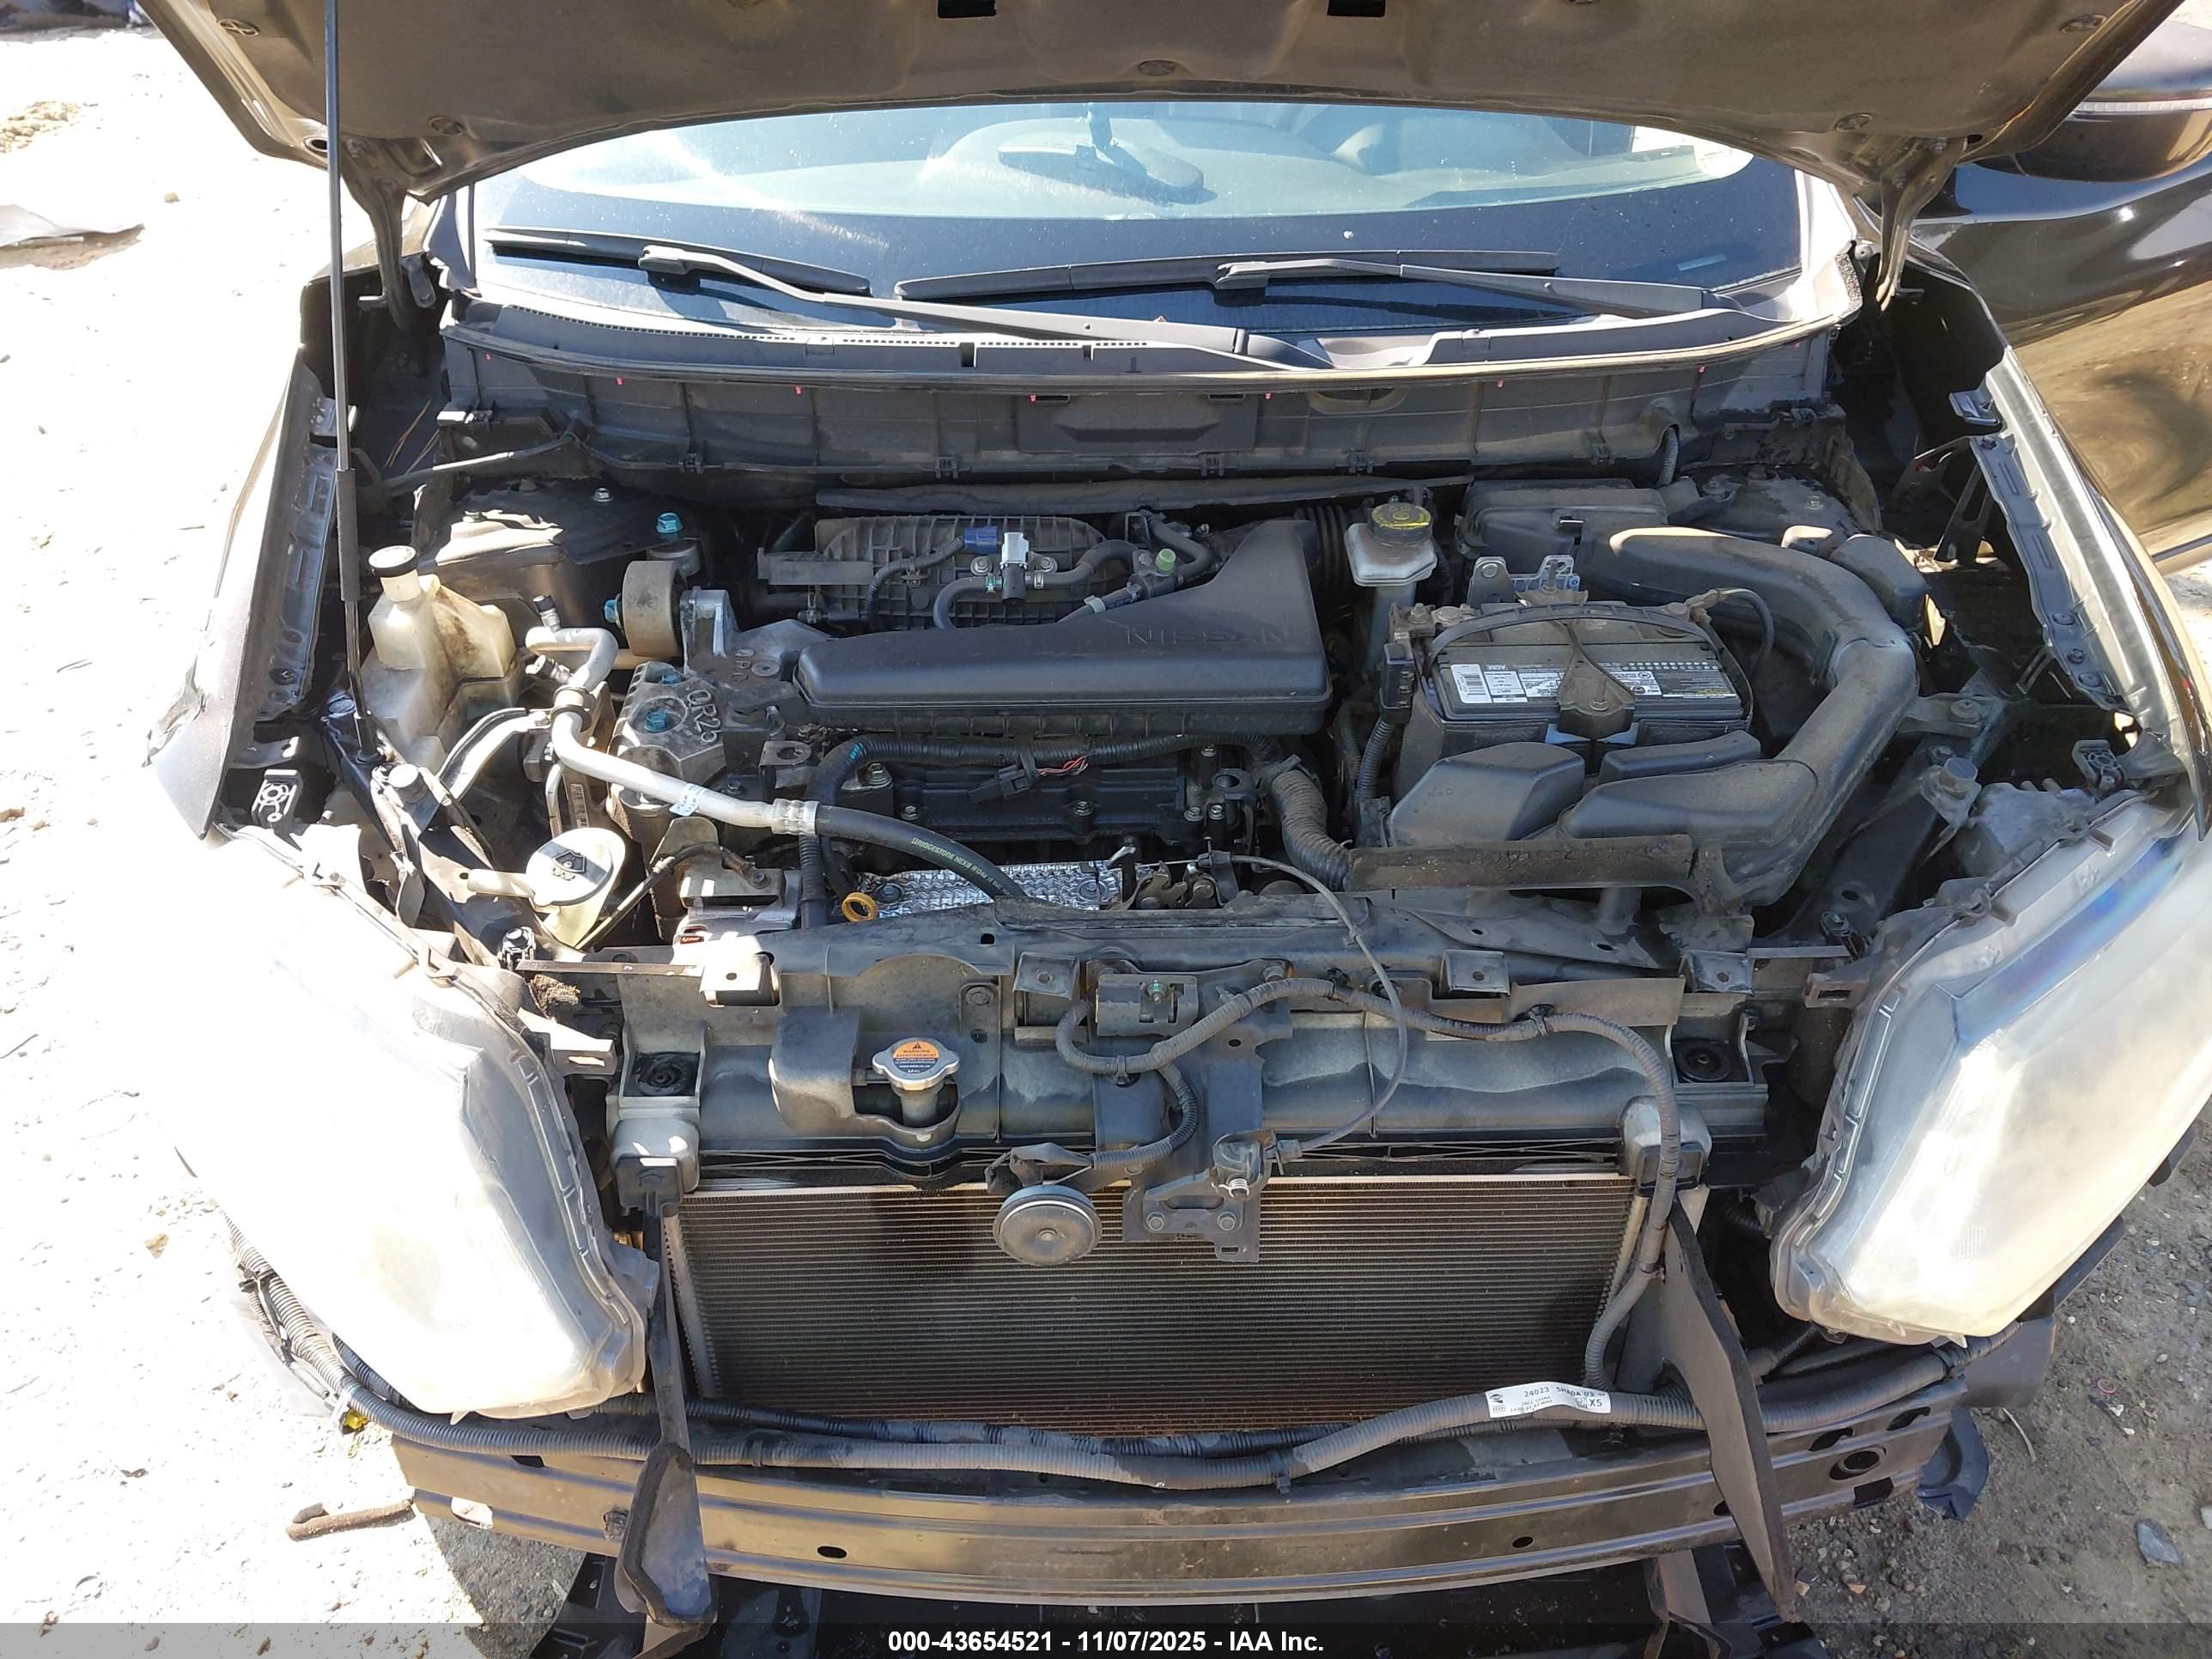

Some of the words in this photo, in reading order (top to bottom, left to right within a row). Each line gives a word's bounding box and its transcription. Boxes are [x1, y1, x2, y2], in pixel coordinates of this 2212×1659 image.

[686, 689, 722, 744] QR25
[911, 837, 954, 860] BRIDGESTONE
[1523, 1386, 1550, 1398] 24023
[1589, 1398, 1603, 1408] X5
